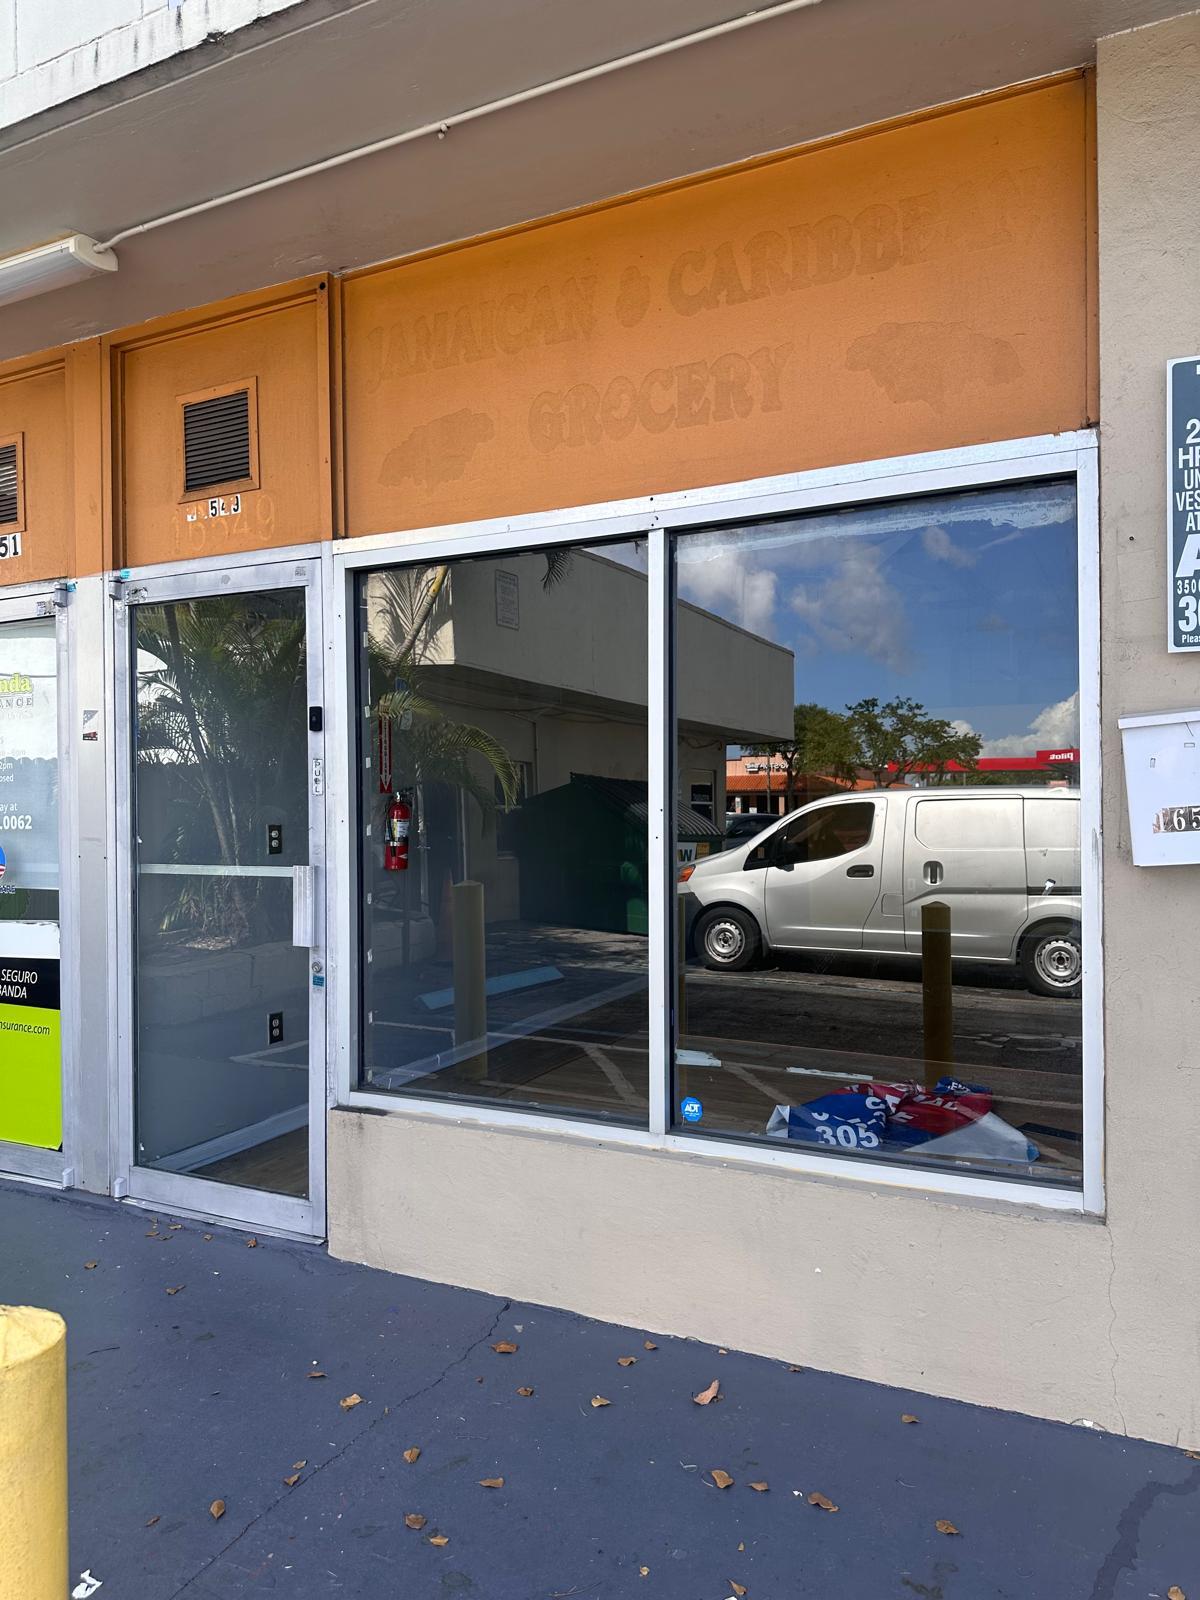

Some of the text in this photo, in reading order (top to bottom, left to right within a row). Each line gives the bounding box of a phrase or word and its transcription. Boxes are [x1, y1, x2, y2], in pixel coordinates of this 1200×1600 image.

[527, 342, 794, 452] GROCERY
[1, 968, 38, 984] SEGURO
[0, 984, 27, 999] ANDA
[684, 1103, 700, 1113] ADT
[815, 1125, 879, 1149] 305
